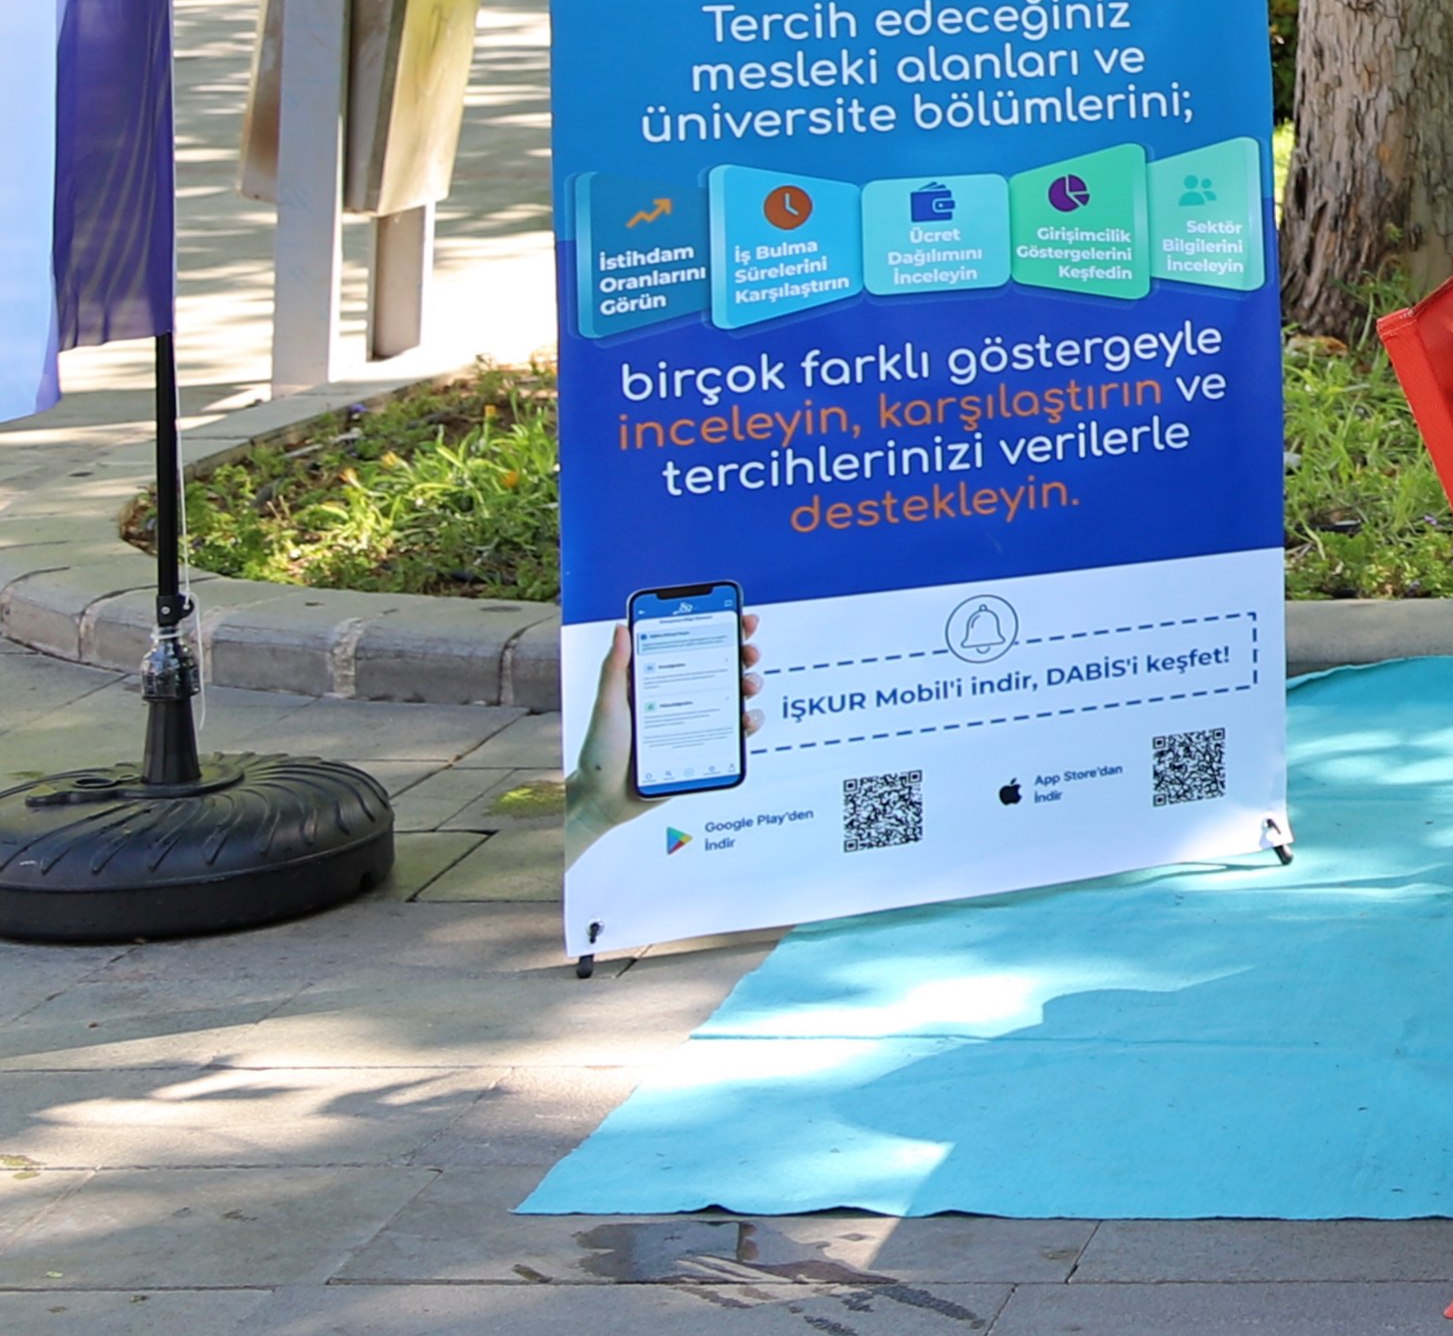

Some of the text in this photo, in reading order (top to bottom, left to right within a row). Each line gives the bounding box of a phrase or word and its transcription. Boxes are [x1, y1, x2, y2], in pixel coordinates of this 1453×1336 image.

[701, 1, 857, 43] Tercih
[692, 42, 1145, 92] mesleki alanları ve
[642, 82, 1193, 143] üniversite bölümlerini;
[908, 223, 961, 247] Ücret
[1036, 226, 1132, 245] Girişimcilik
[1183, 217, 1243, 236] Sektör
[599, 246, 695, 271] İstihdam
[734, 241, 818, 266] İş Bulma
[887, 246, 983, 268] Dağılımını
[1016, 245, 1132, 262] Göstergelerini
[1160, 236, 1243, 259] Bilgilerini
[733, 254, 828, 286] Sürelerini
[893, 266, 978, 287] İnceleyin
[1058, 265, 1133, 282] Keşfedin
[1166, 255, 1245, 275] İnceleyin
[599, 266, 710, 293] Oranlarını
[734, 275, 850, 304] Karşılaştırın
[600, 293, 667, 316] Görün
[622, 321, 1227, 406] birçok farklı göstergeyle
[620, 373, 1227, 451] inceleyin, karşılaştırın ve
[662, 415, 1190, 496] tercihlerinizi verilerle
[790, 475, 1079, 533] destekleyin.
[782, 645, 1230, 723] İŞKUR Mobil'i indir, DABİS'i keşfet!
[1034, 774, 1061, 787] App
[1033, 790, 1063, 804] İndir
[704, 817, 754, 833] Google
[704, 837, 736, 852] İndir
